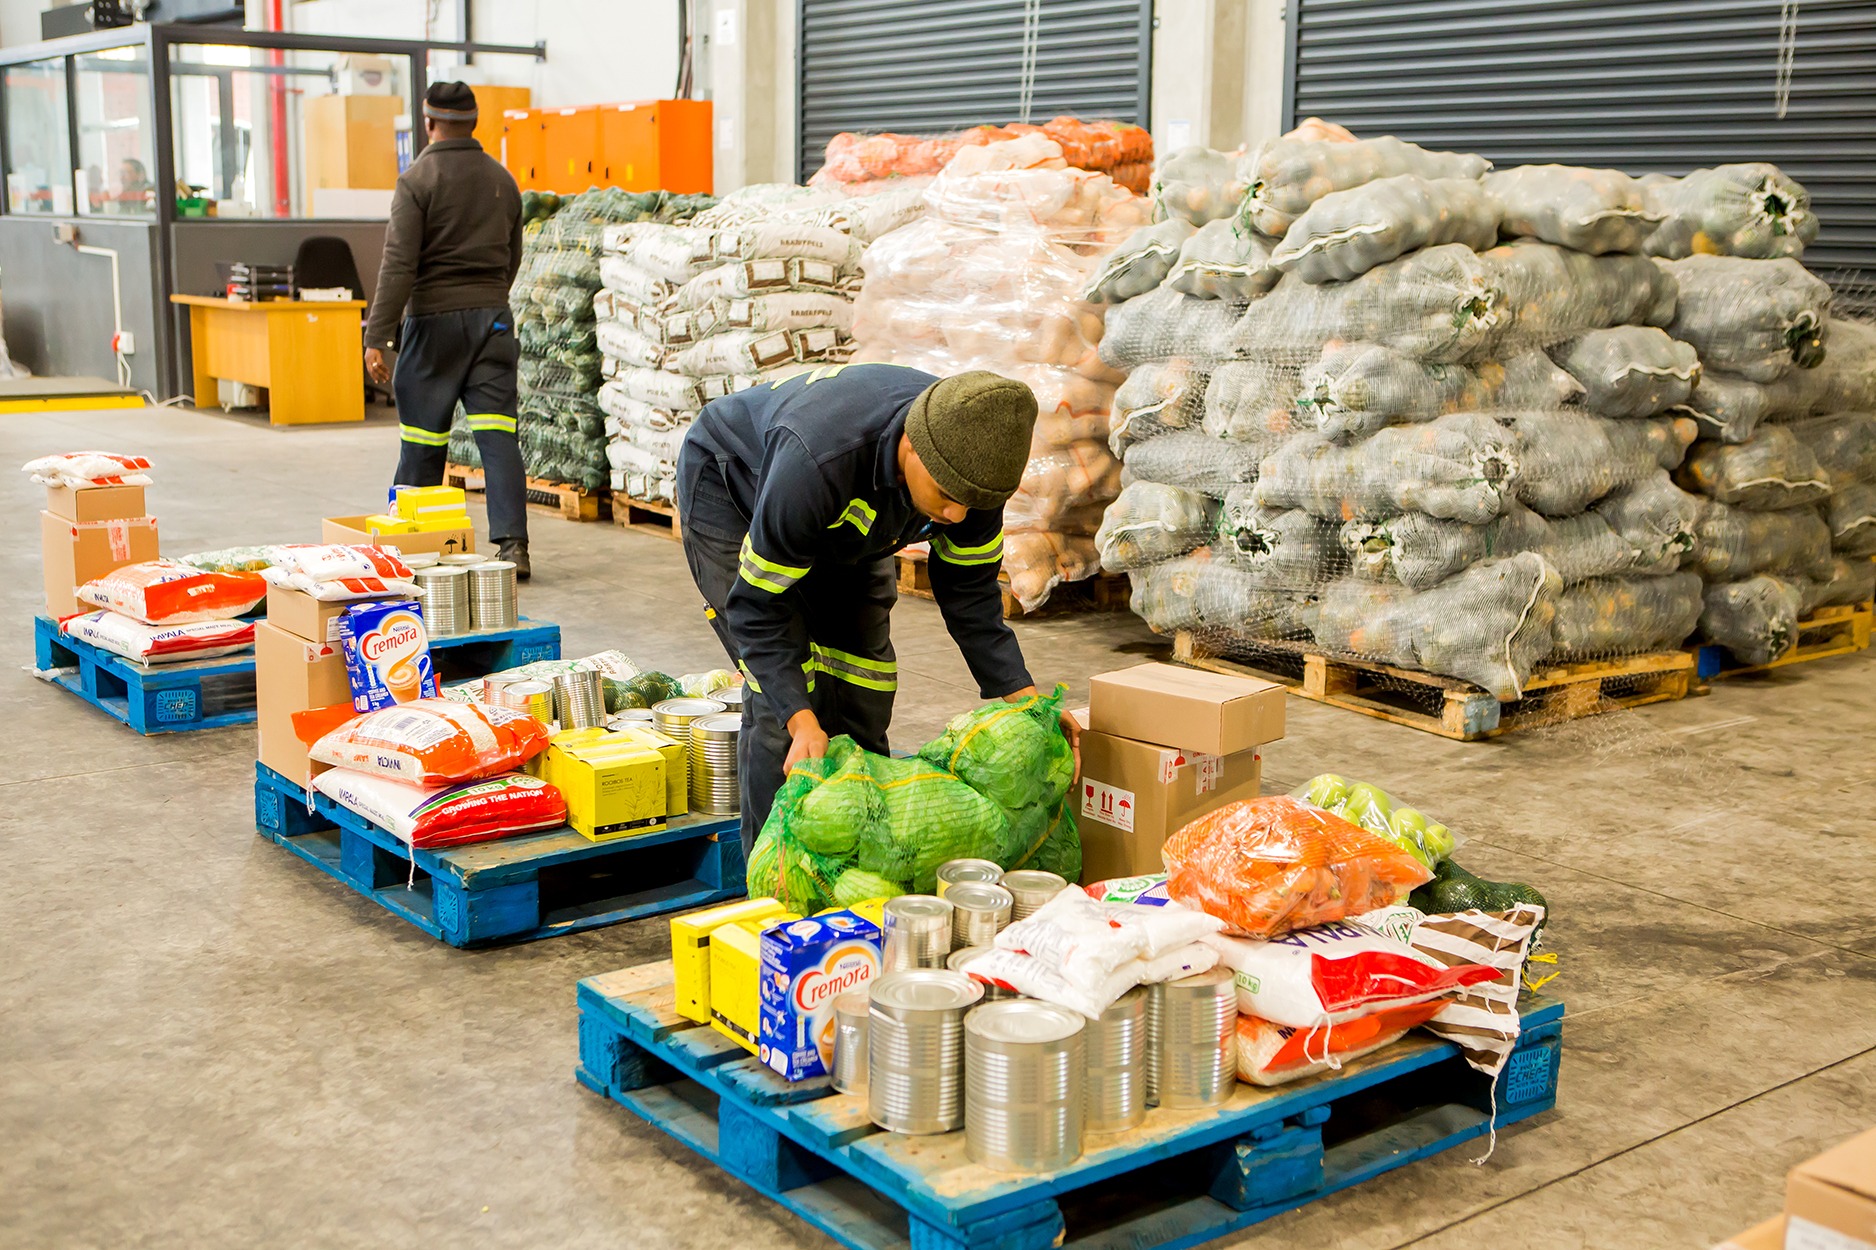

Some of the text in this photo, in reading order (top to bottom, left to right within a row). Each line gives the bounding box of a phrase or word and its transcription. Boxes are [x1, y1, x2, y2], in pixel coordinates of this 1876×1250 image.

[361, 627, 418, 661] Cremora
[441, 788, 544, 816] GROWING THE NATION
[795, 963, 870, 1011] Cremora
